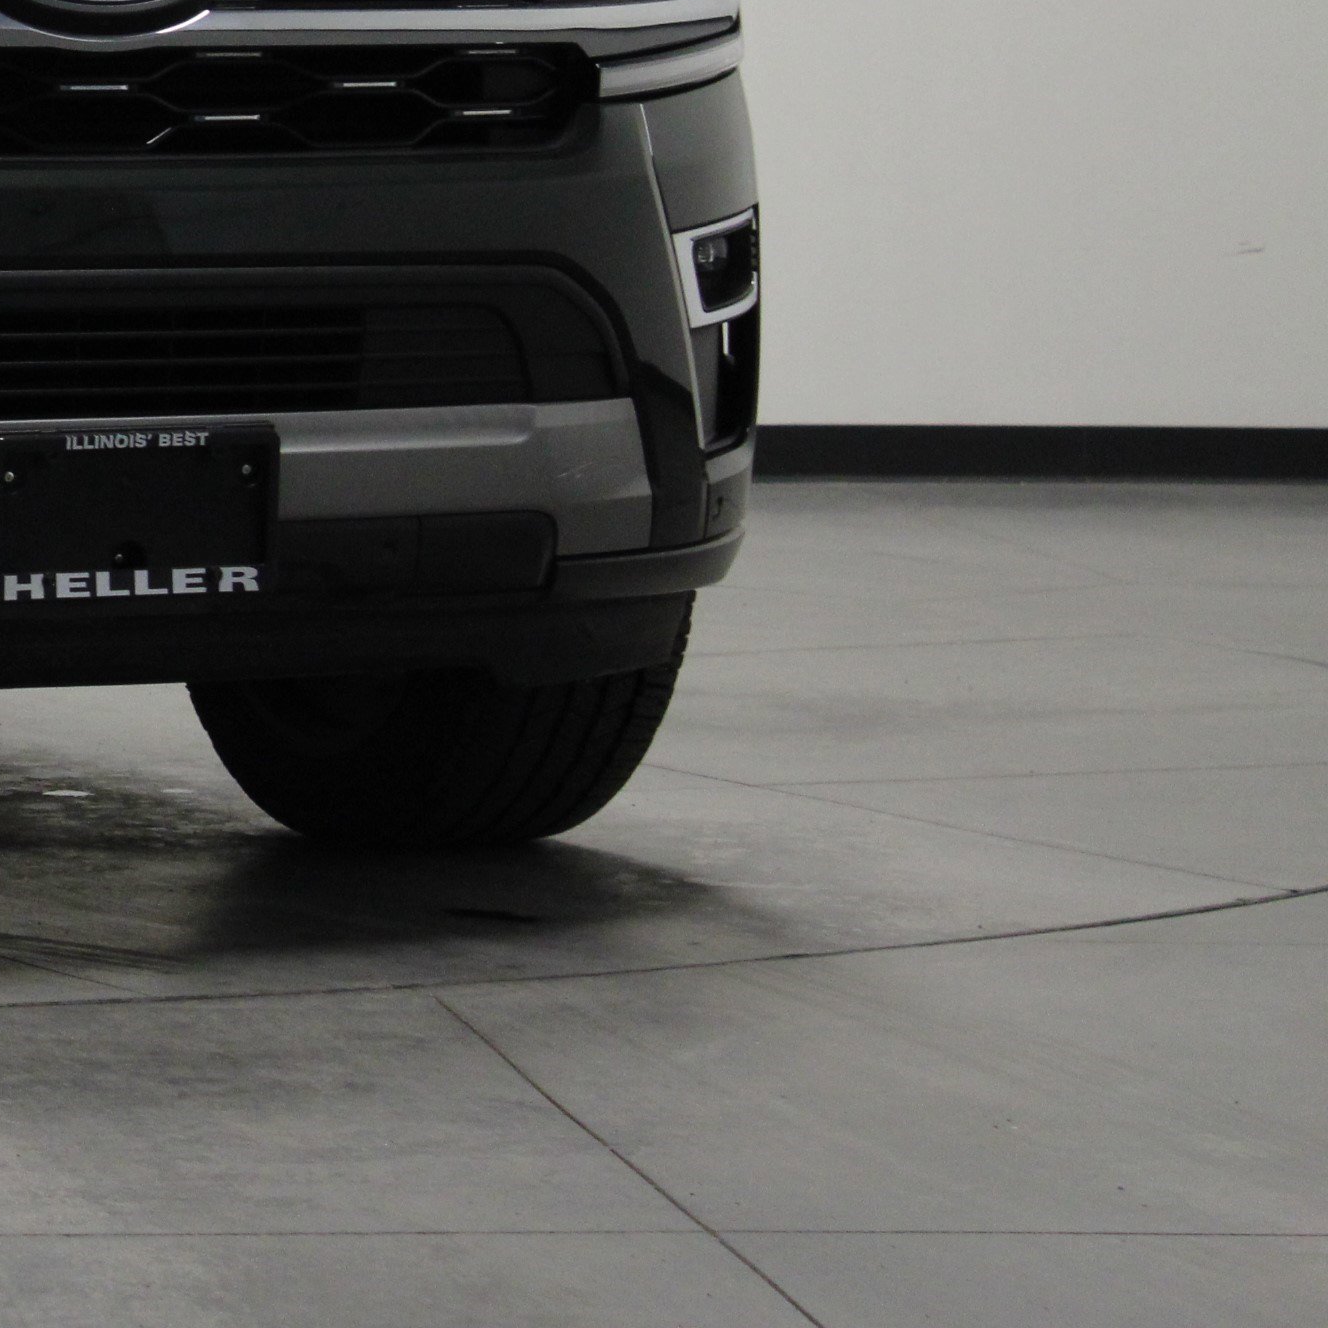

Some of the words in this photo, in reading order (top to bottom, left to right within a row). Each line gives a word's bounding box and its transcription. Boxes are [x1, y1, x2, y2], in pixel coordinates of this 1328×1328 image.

[66, 433, 152, 451] ILLINOIS'
[159, 431, 209, 447] BEST
[4, 566, 260, 601] HELLER
